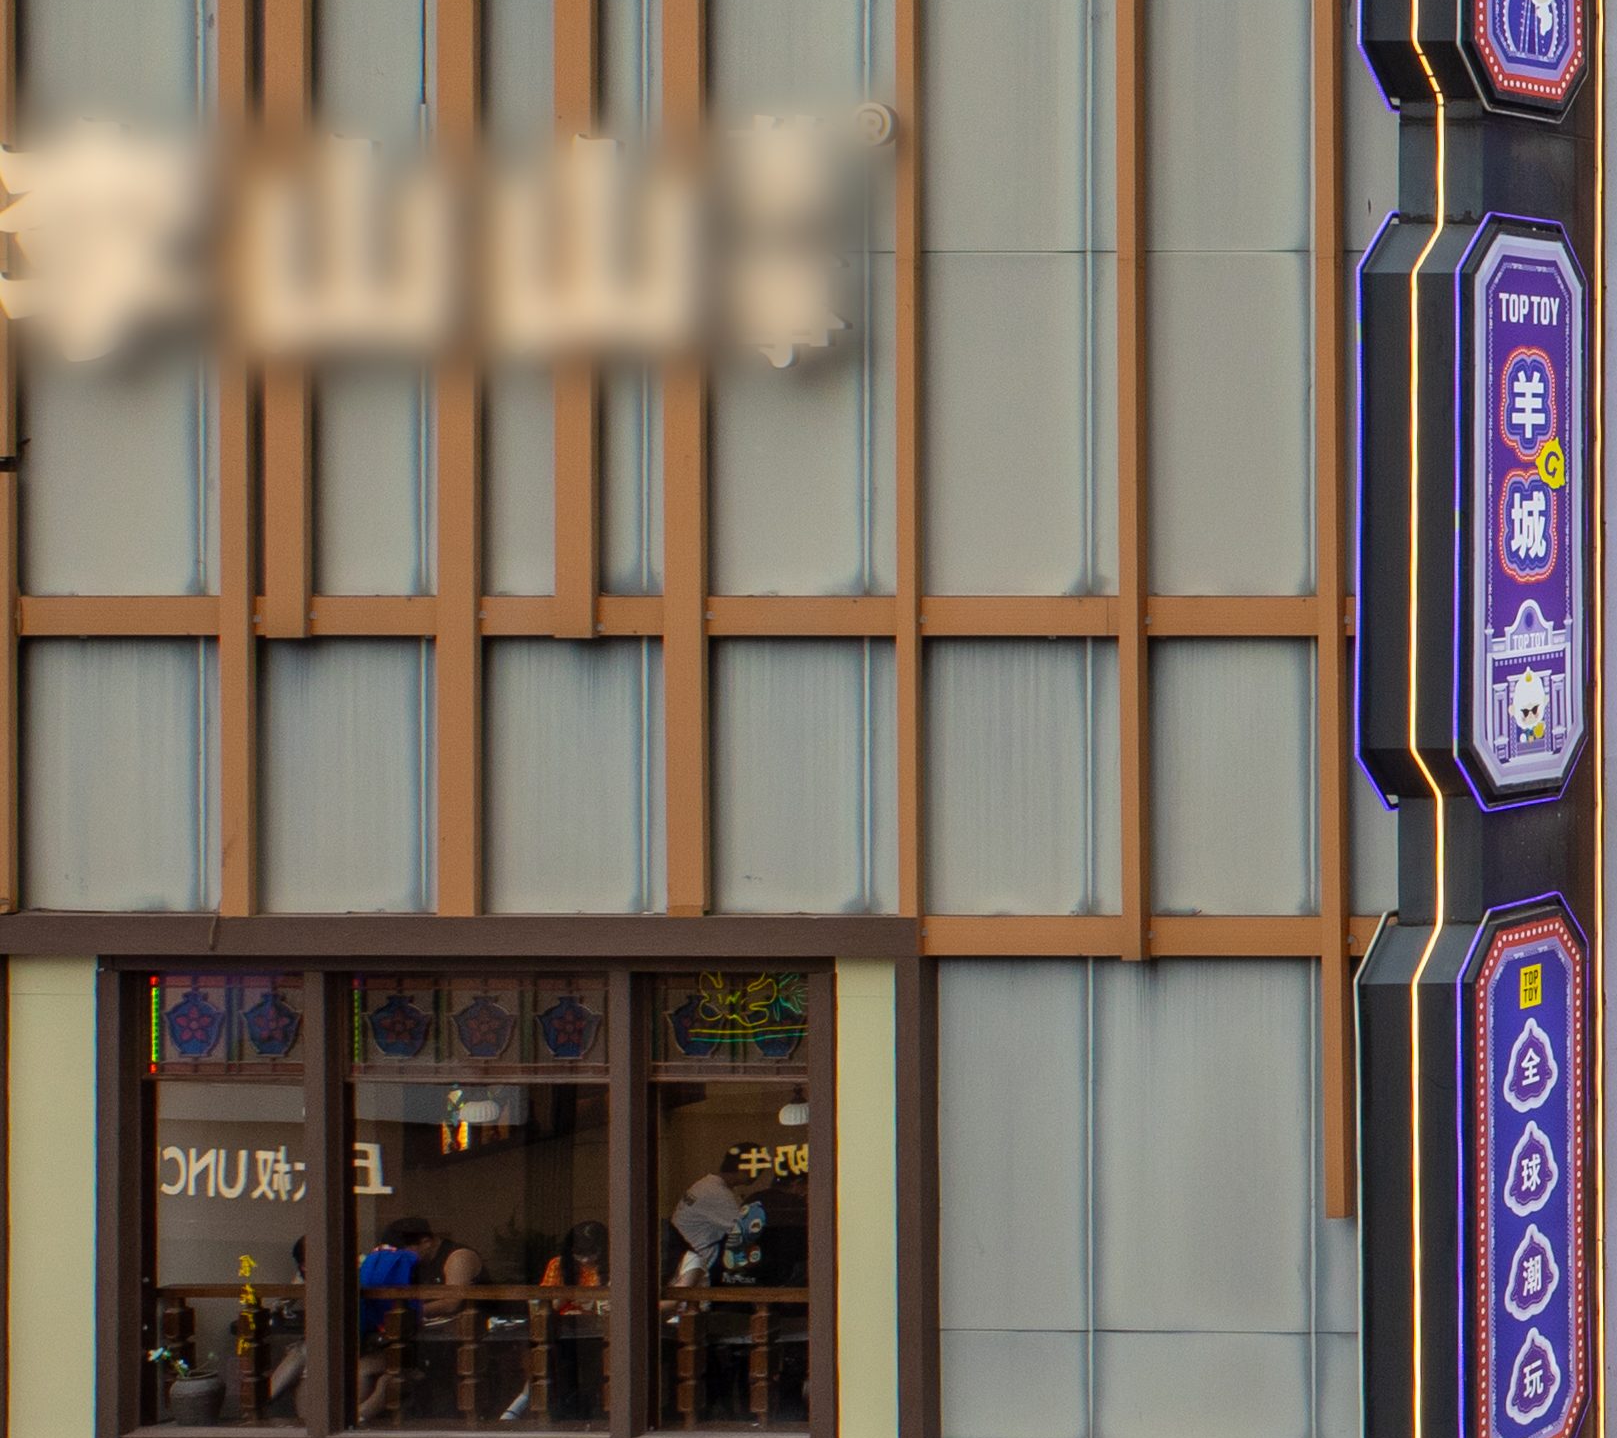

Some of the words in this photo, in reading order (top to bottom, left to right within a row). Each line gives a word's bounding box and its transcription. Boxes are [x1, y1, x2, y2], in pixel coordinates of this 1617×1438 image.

[1500, 292, 1529, 324] TOP
[1531, 294, 1560, 326] TOY
[1511, 371, 1547, 560] 羊城
[1523, 969, 1540, 987] TOP
[1523, 986, 1540, 1004] TOY
[1521, 1048, 1544, 1398] 全球潮玩
